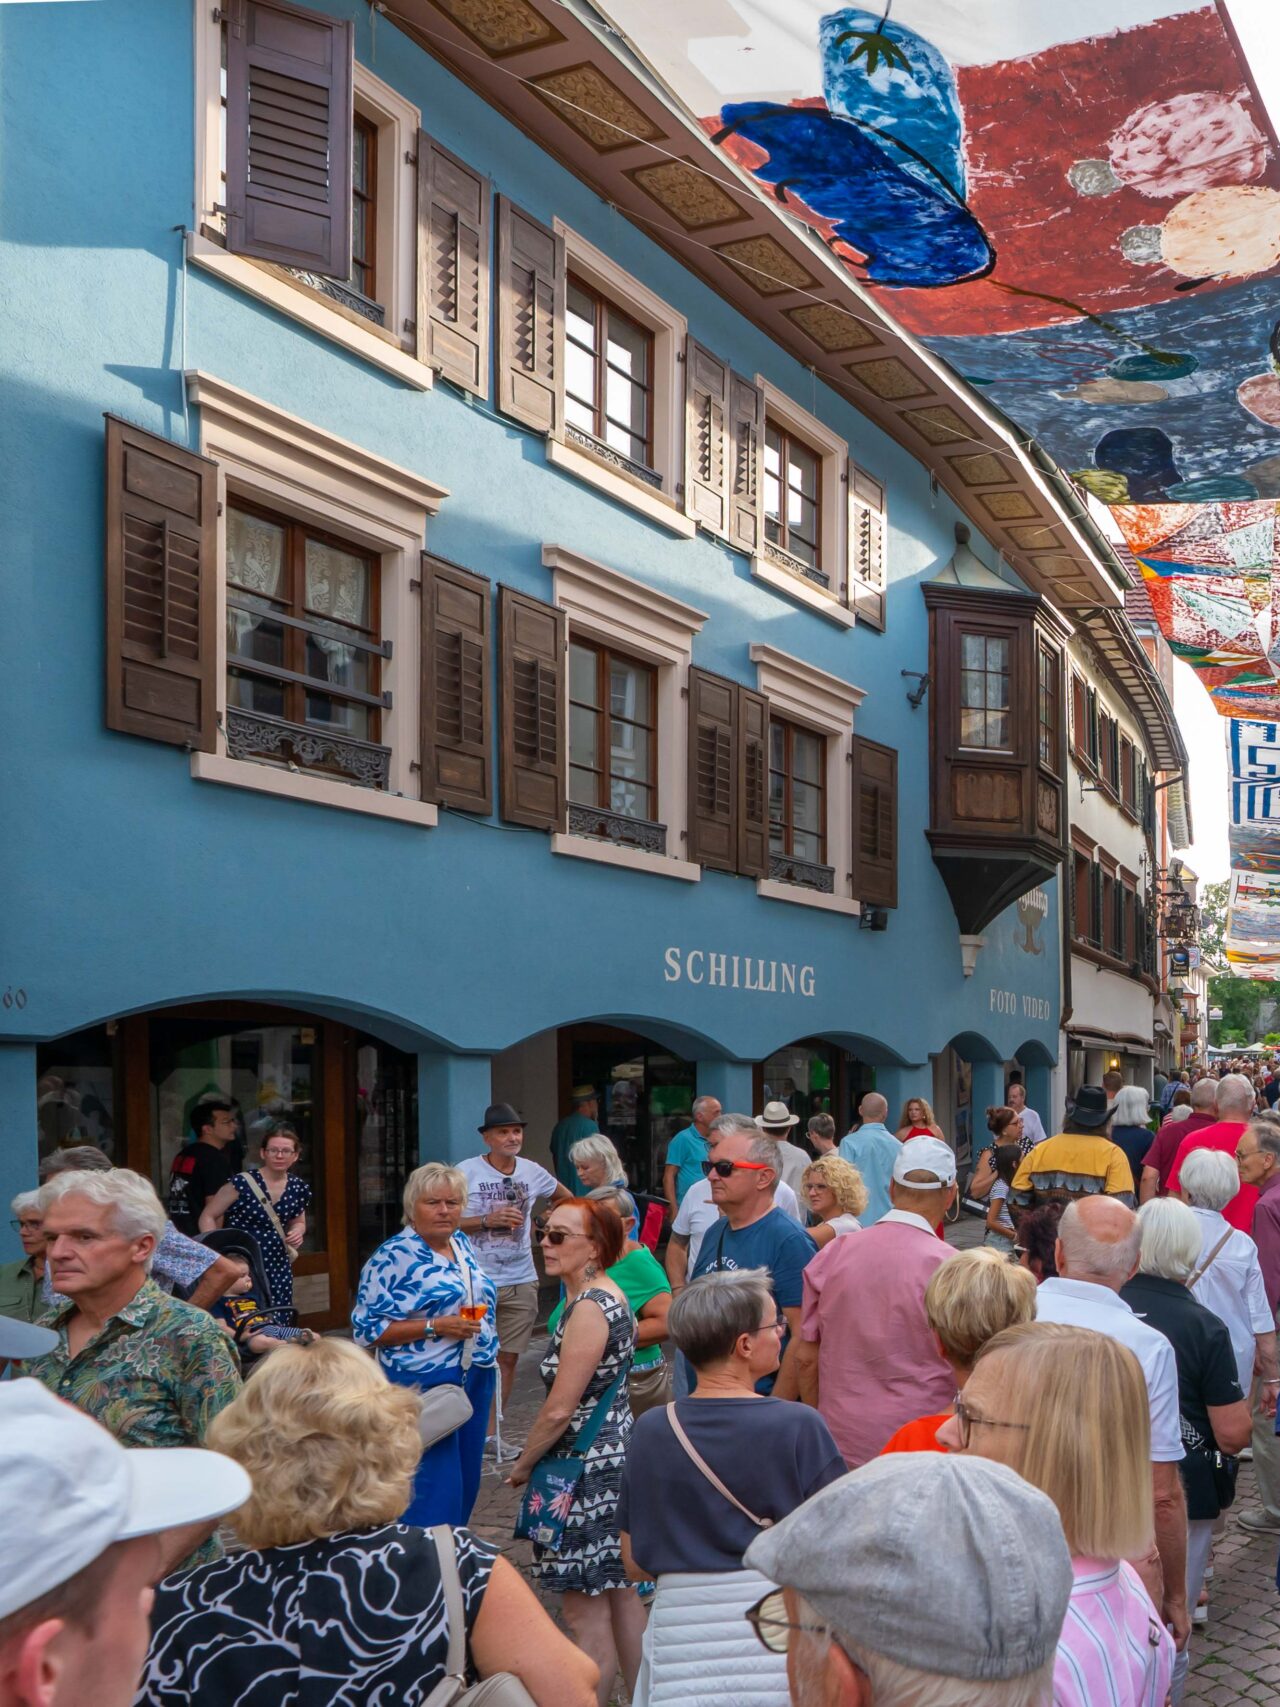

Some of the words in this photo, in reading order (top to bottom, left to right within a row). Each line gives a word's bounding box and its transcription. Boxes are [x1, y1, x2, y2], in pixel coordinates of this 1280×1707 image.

[664, 947, 815, 997] SCHILLING
[3, 985, 27, 1009] 60
[990, 989, 1016, 1016] FOTO
[1022, 995, 1050, 1021] VIDEO
